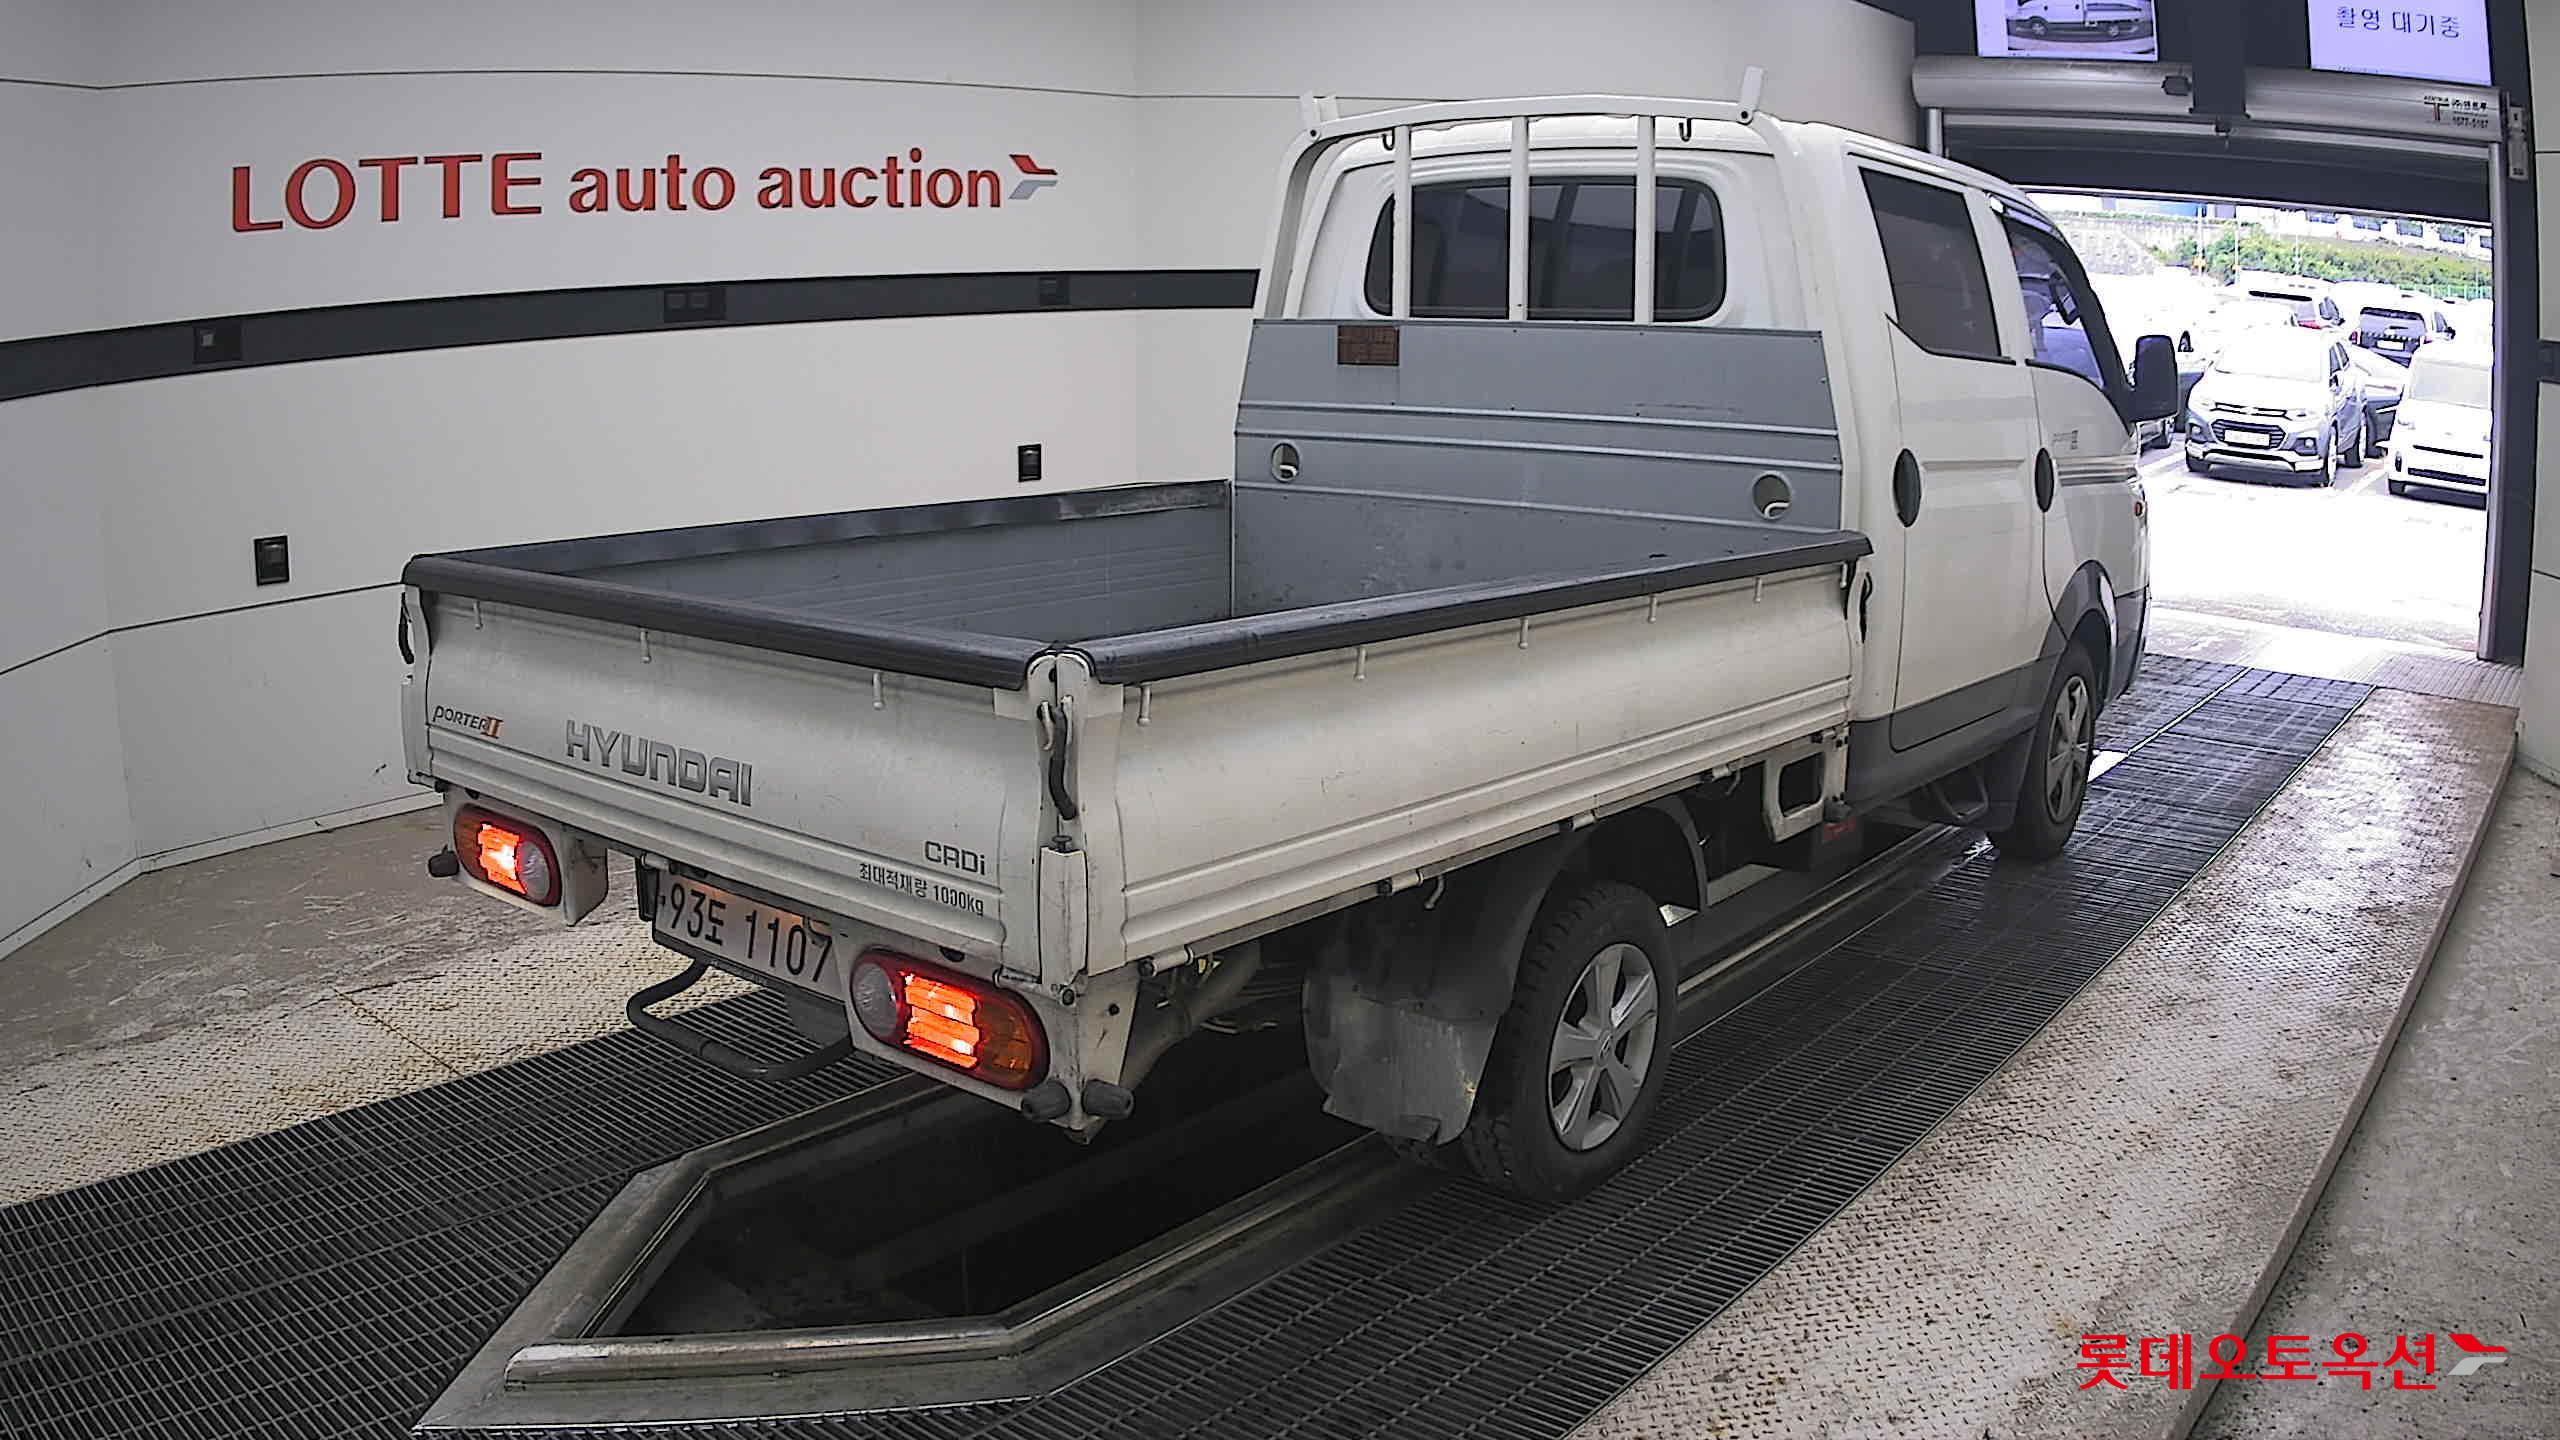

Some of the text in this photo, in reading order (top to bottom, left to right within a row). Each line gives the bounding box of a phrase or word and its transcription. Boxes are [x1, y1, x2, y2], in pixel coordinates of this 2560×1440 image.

[2337, 6, 2460, 38] 촬영 대기중
[231, 147, 1001, 233] LOTTE auto auction
[432, 705, 490, 730] PORTER
[566, 719, 752, 807] HYUNDAI
[924, 840, 986, 876] CRDi
[859, 862, 928, 898] 최대적재량
[670, 882, 834, 984] 93도 1107
